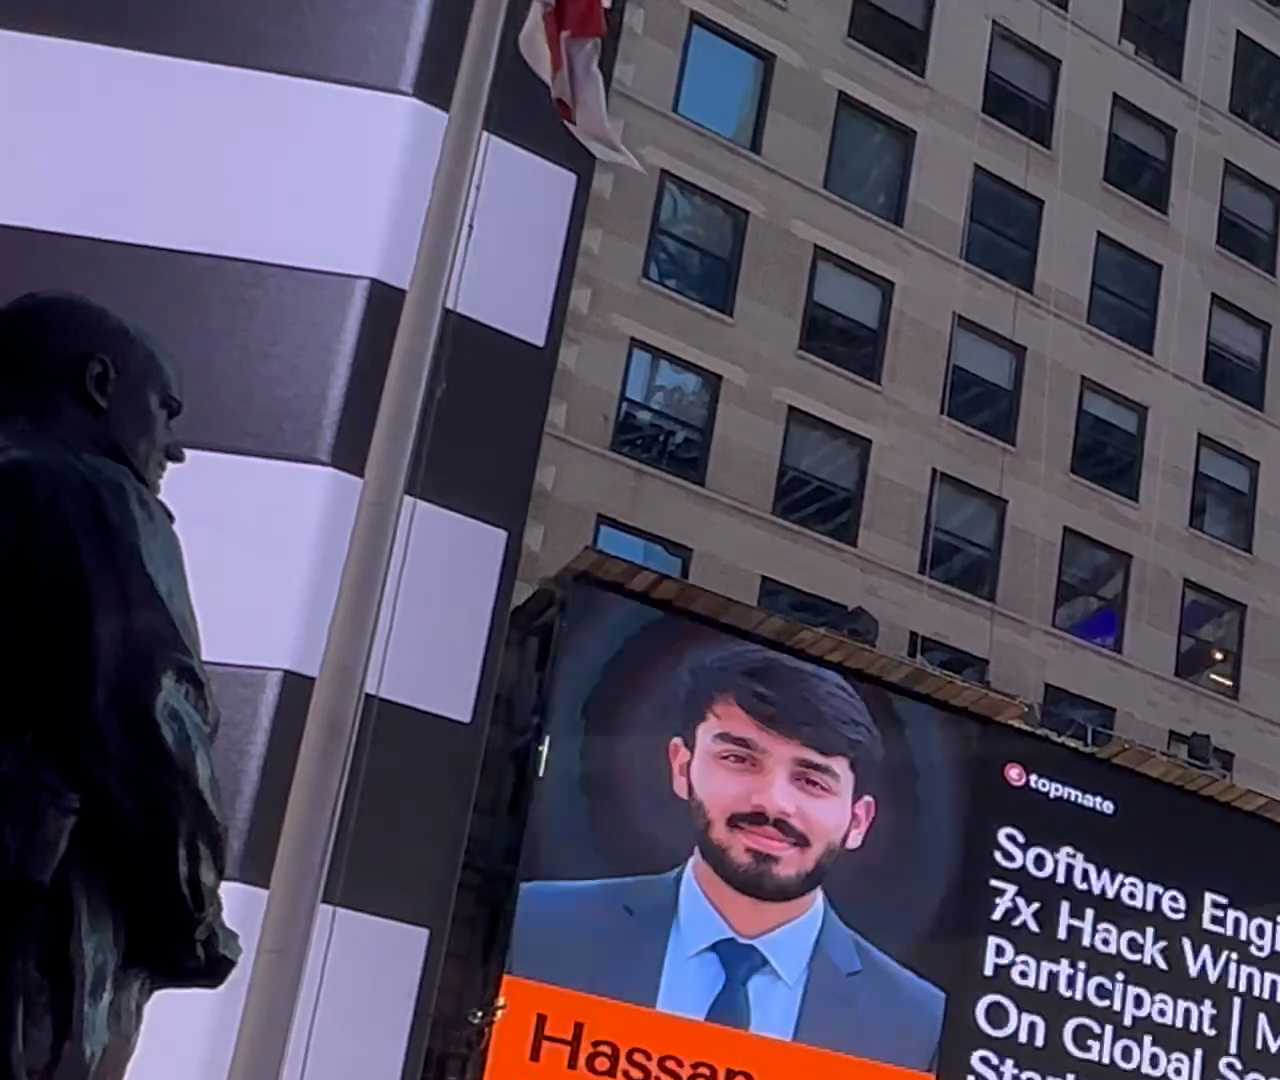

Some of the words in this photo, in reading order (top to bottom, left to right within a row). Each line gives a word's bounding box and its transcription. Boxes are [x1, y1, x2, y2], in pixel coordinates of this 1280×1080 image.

[1029, 771, 1115, 815] topmate
[993, 826, 1187, 920] Software
[988, 879, 1041, 935] 7x
[1057, 900, 1169, 971] Hack
[974, 993, 1046, 1049] On
[983, 935, 1218, 1037] Participant
